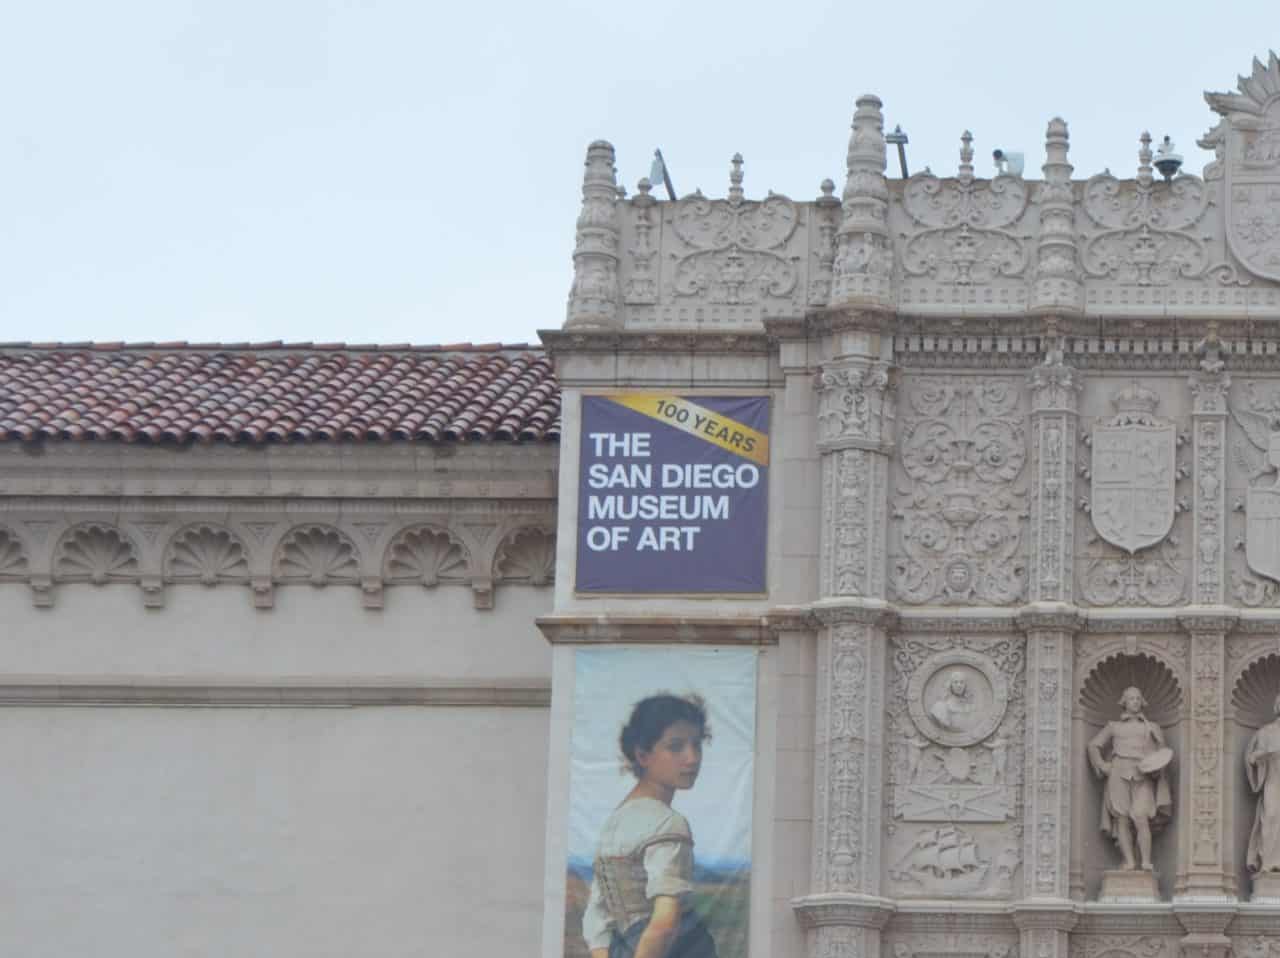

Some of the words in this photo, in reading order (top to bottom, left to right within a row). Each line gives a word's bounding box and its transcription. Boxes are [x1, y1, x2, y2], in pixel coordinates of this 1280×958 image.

[655, 400, 690, 423] 100
[694, 414, 757, 453] YEARS
[589, 432, 651, 457] THE
[588, 463, 652, 488] SAN
[661, 463, 759, 489] DIEGO
[588, 495, 729, 520] MUSEUM
[586, 526, 630, 551] OF
[636, 527, 701, 551] ART
